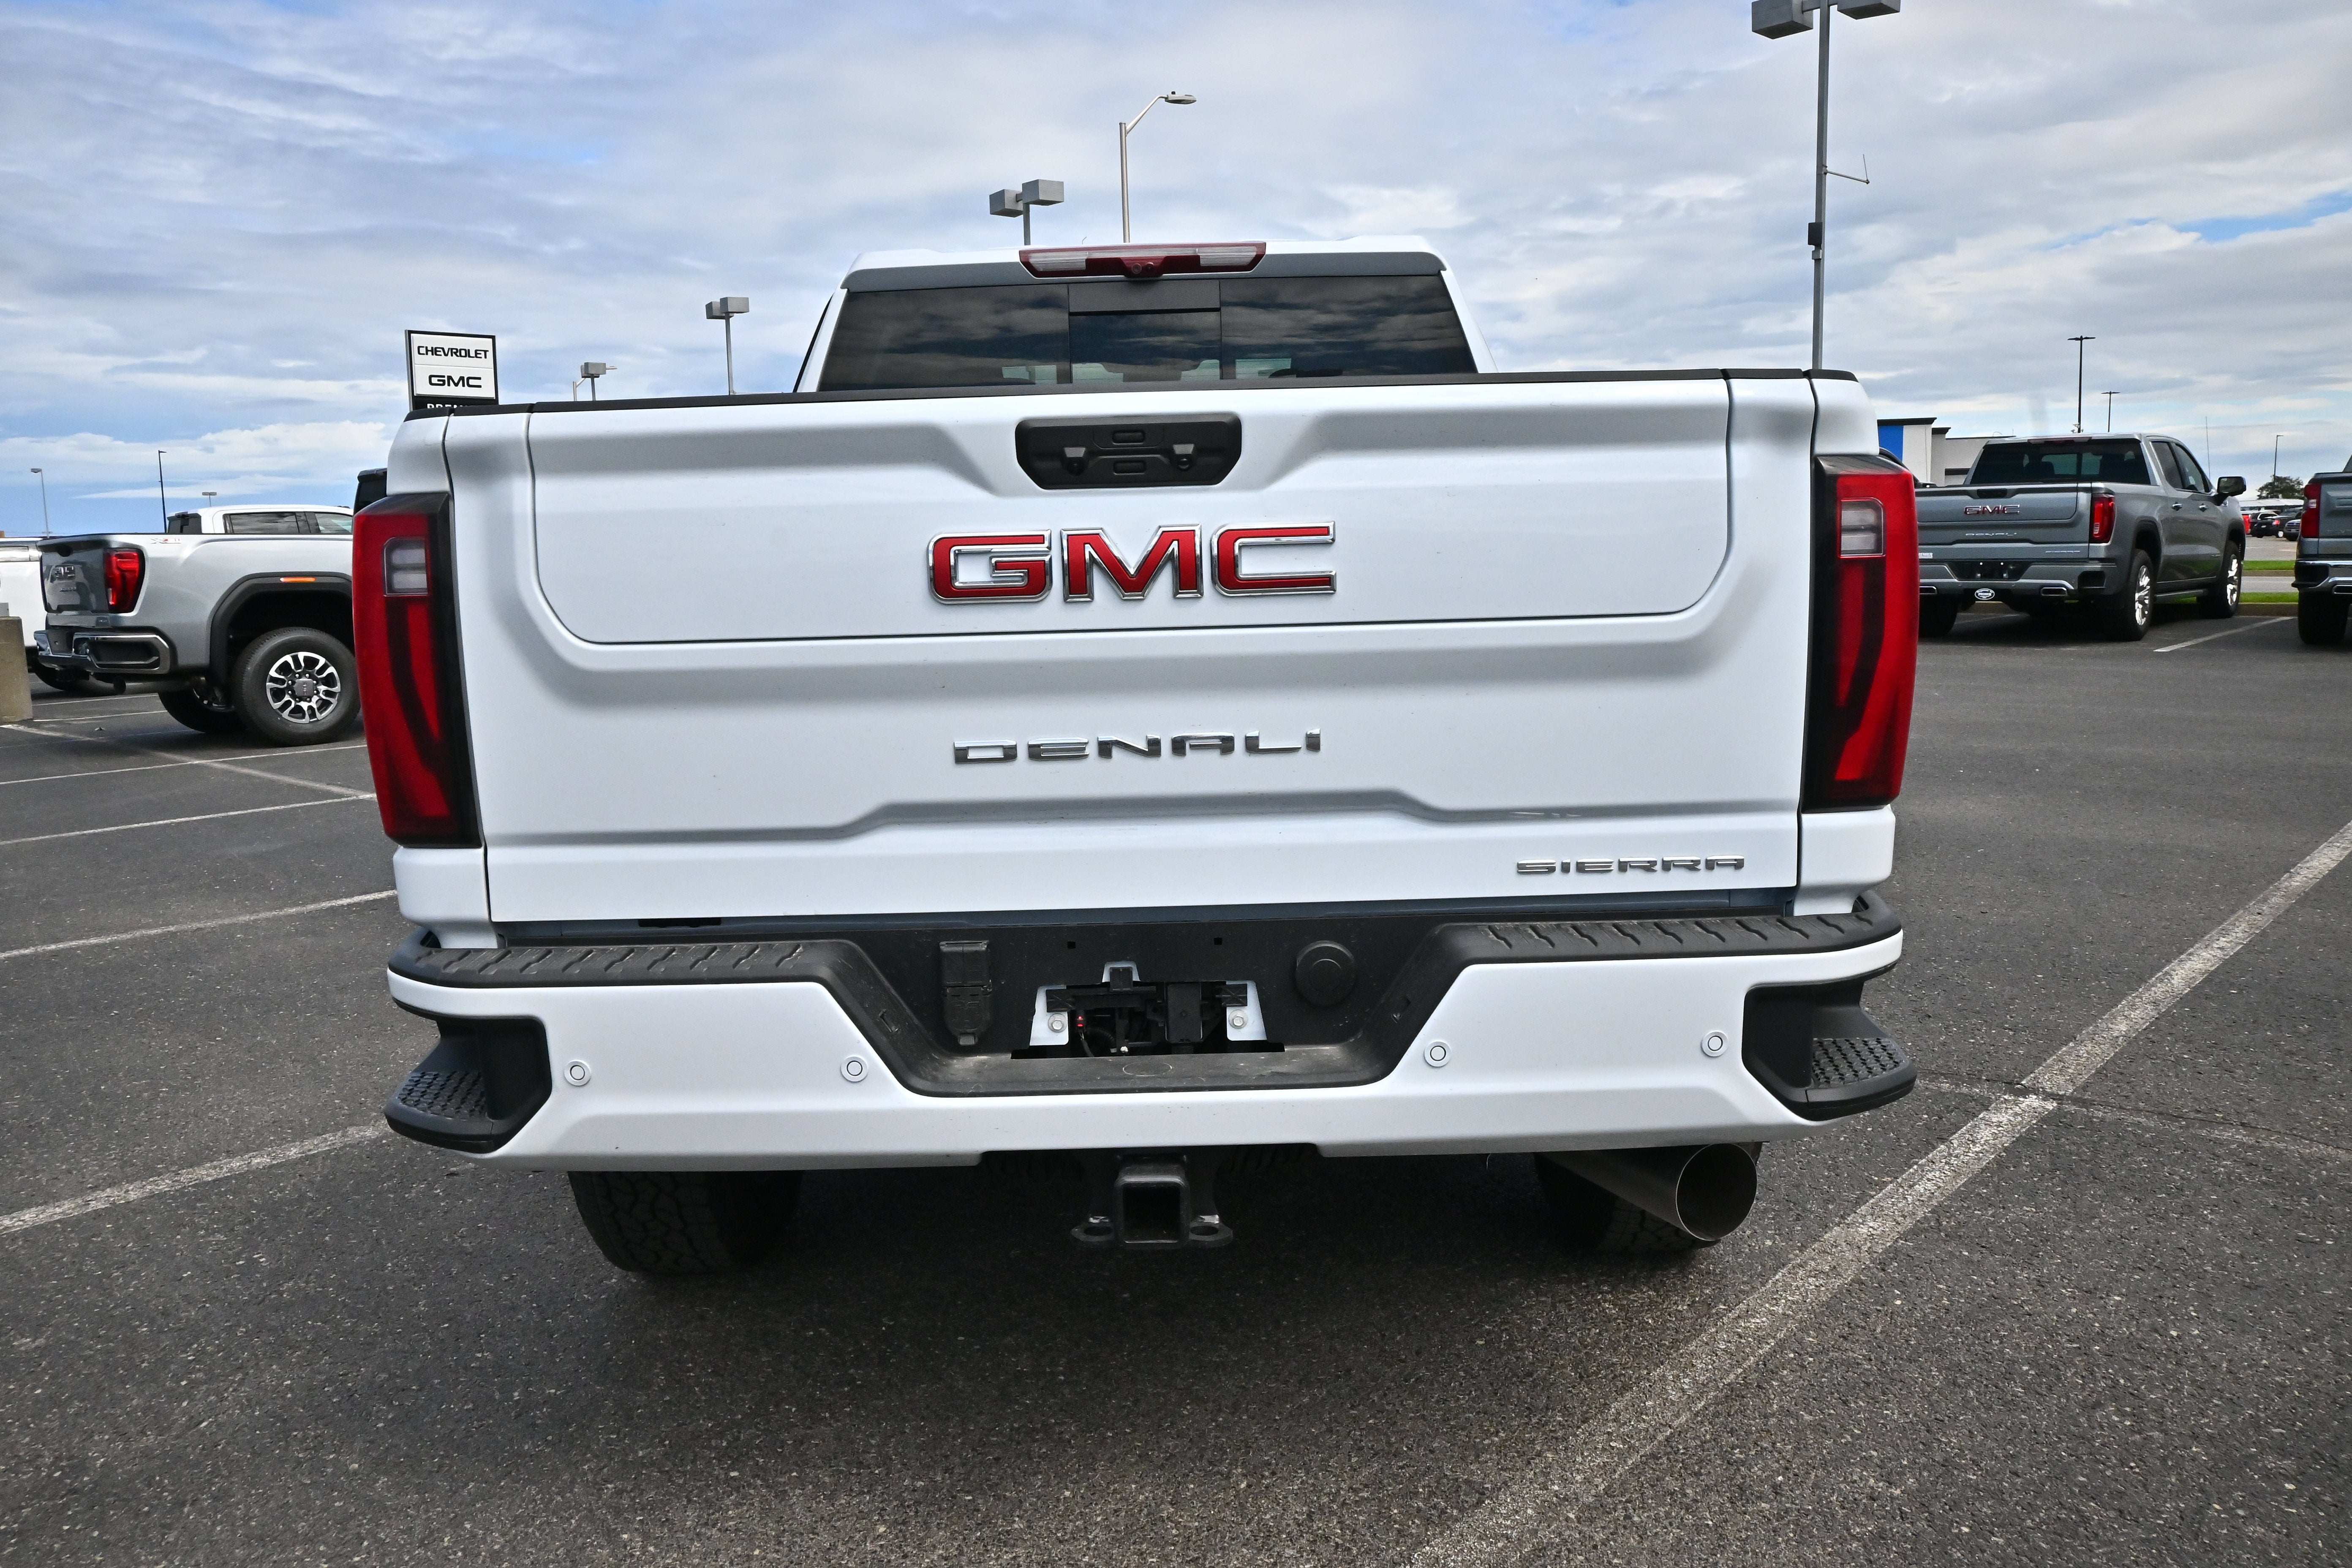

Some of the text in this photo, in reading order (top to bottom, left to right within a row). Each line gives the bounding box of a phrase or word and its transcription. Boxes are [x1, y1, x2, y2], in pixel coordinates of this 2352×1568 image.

[417, 346, 489, 359] CHEVROLET
[428, 374, 482, 388] GMC
[1964, 504, 2020, 515] GMC
[926, 521, 1337, 604] GMC
[954, 728, 1321, 764] DENALI
[1517, 854, 1745, 874] SIERRA
